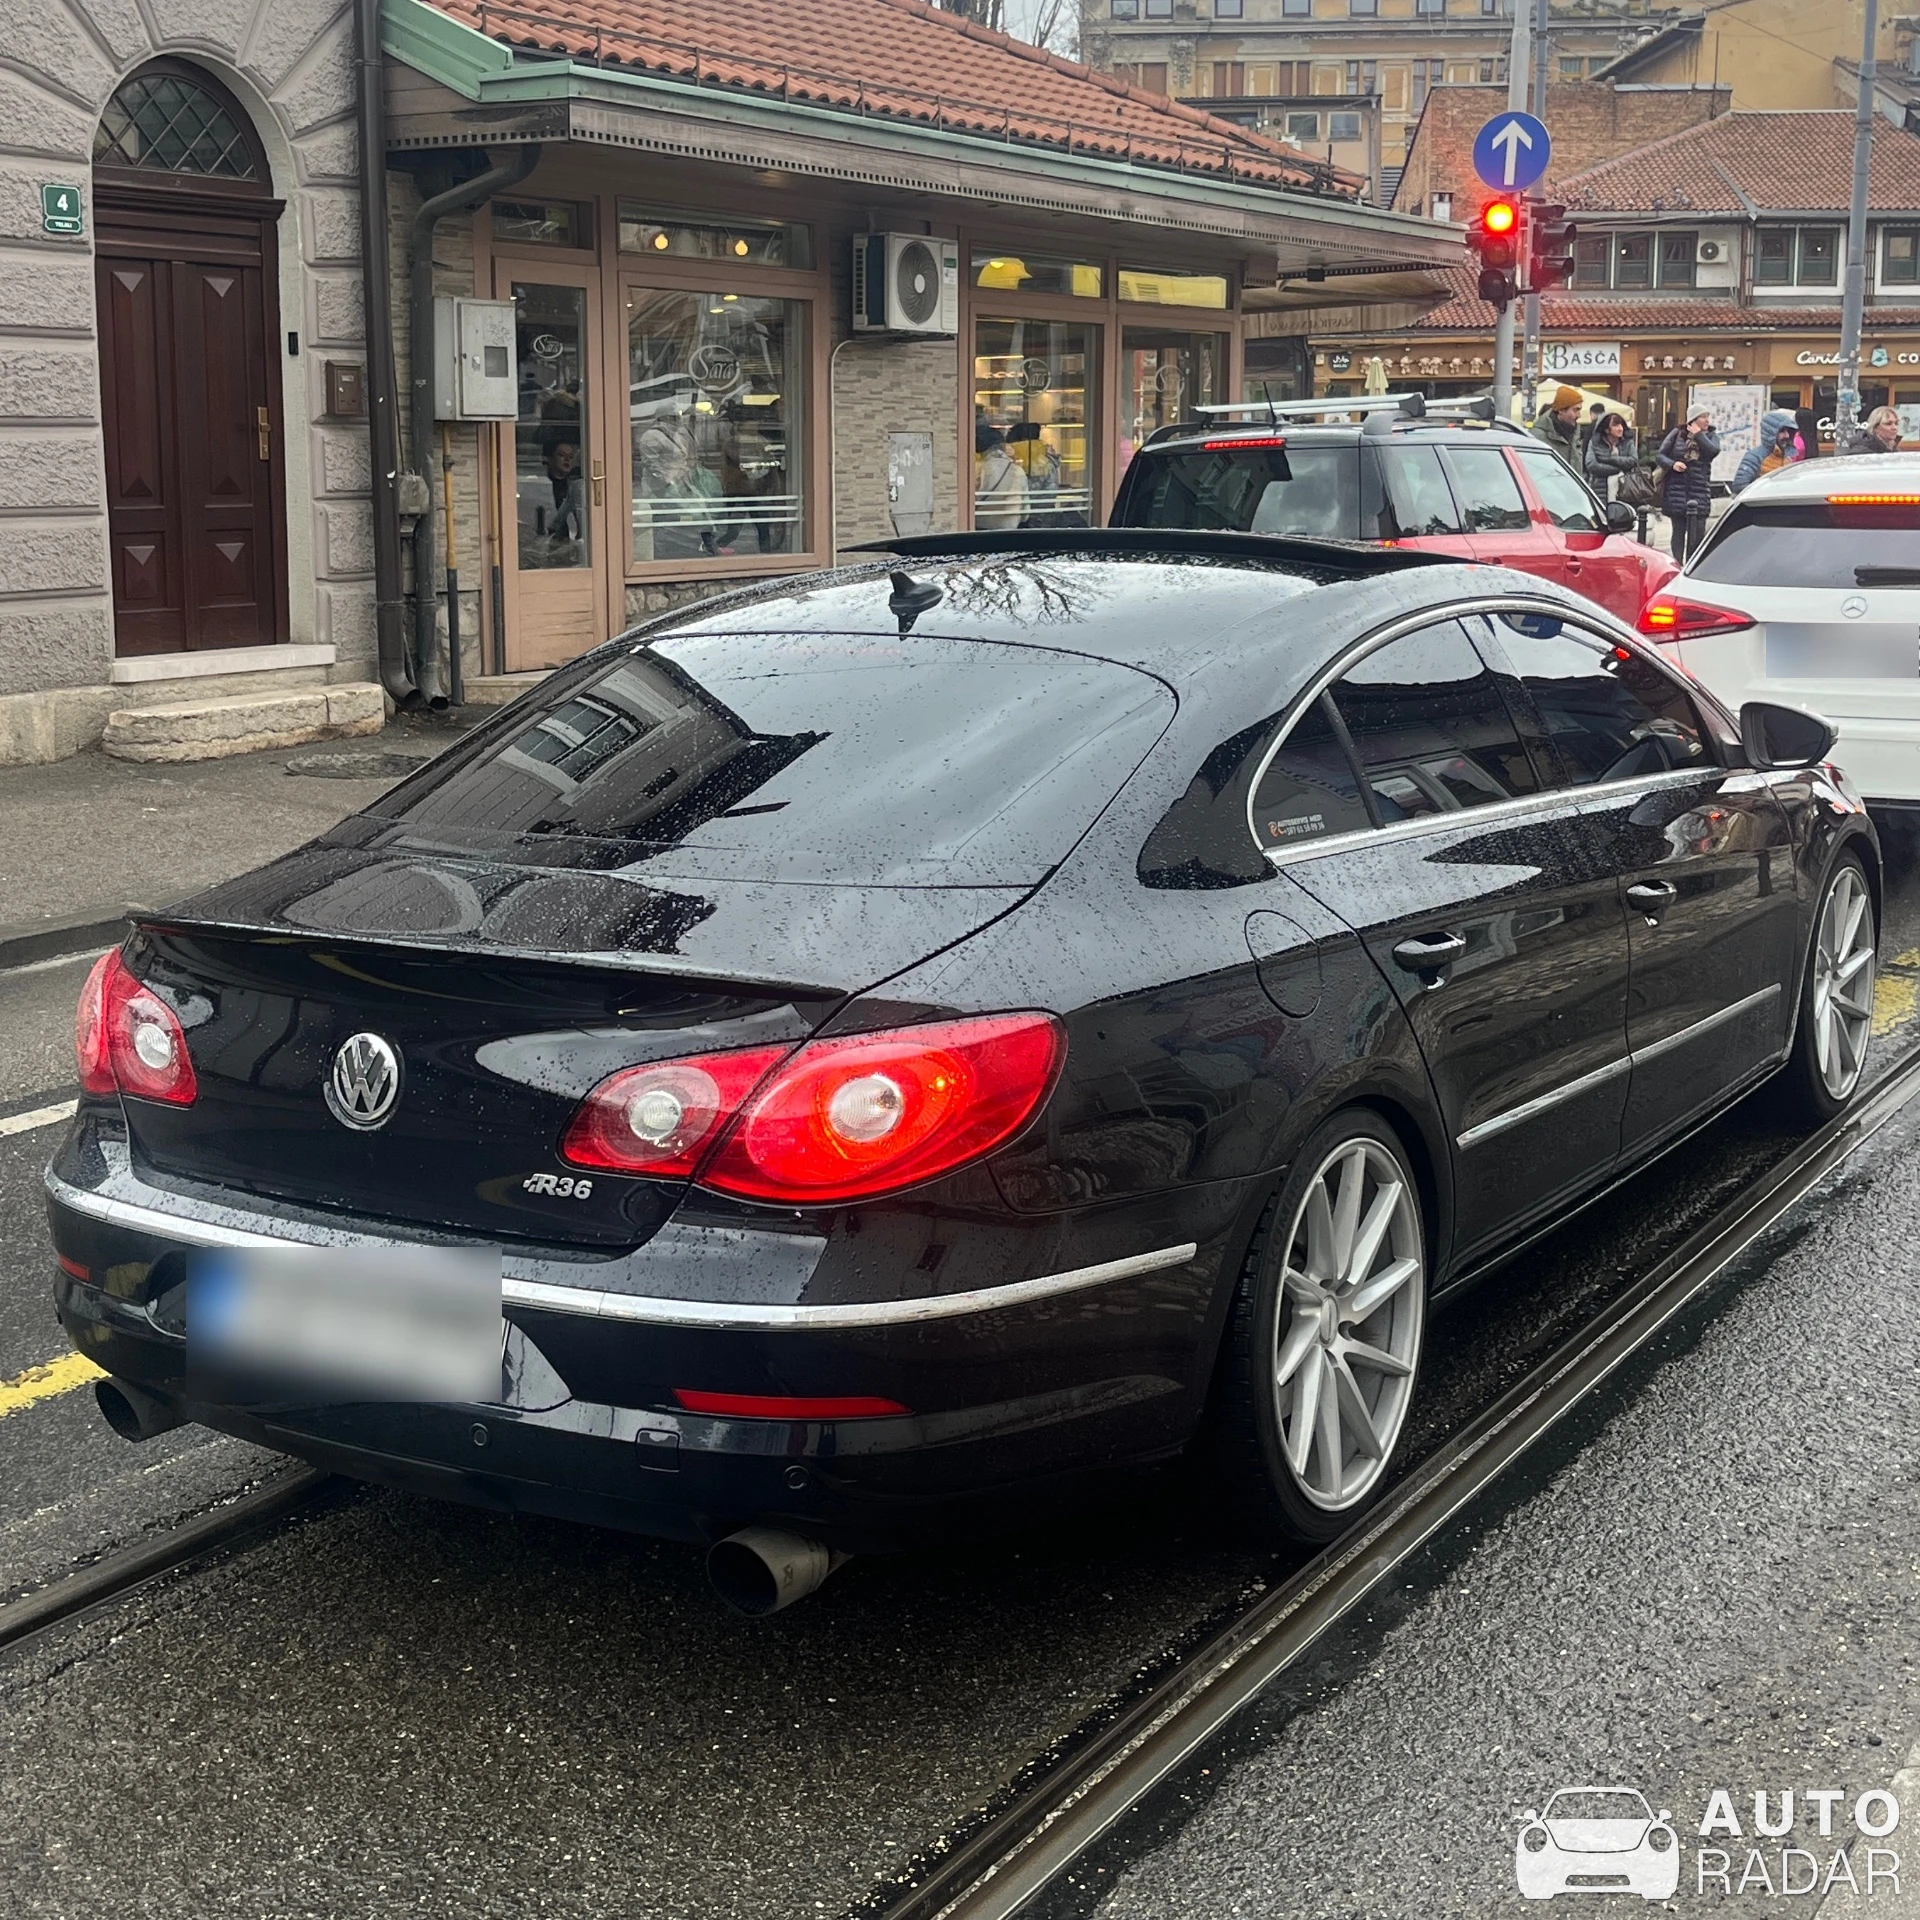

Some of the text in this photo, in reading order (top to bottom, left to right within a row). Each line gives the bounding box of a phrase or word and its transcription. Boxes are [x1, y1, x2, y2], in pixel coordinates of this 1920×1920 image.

[57, 194, 68, 211] 4
[1553, 344, 1618, 369] BAŠČA
[533, 1173, 593, 1200] R36
